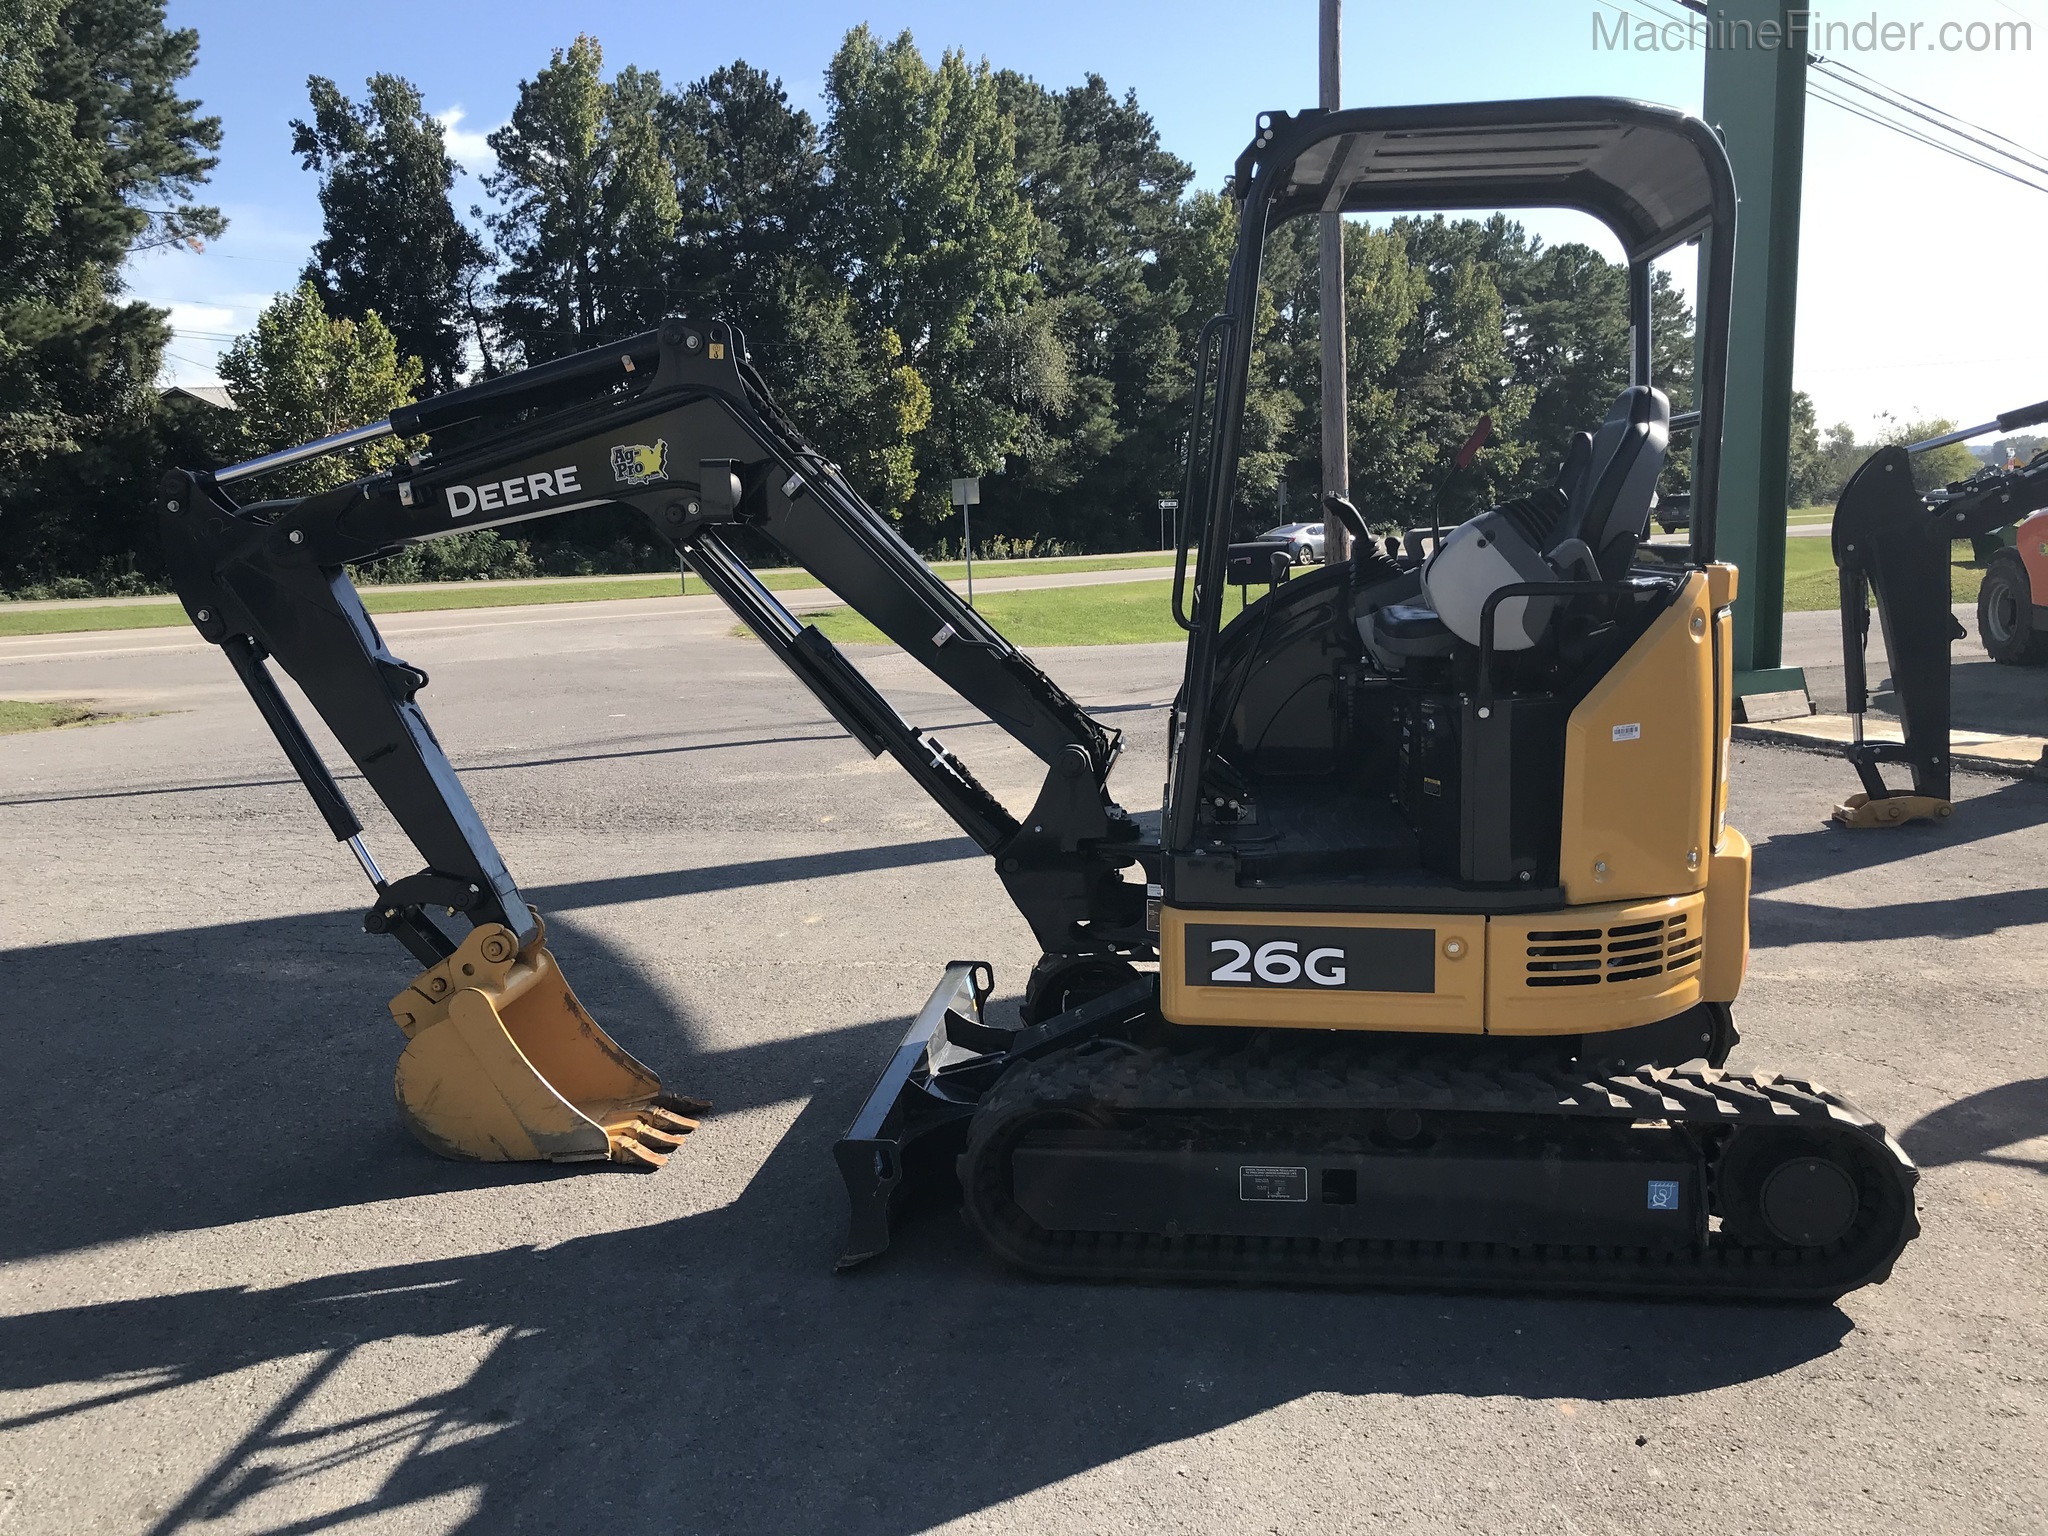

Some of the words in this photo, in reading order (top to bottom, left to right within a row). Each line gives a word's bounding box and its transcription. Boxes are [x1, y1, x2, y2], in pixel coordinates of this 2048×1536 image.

[614, 449, 640, 464] Ag-
[616, 463, 644, 477] Pro
[445, 465, 582, 518] DEERE
[1211, 939, 1346, 986] 26G
